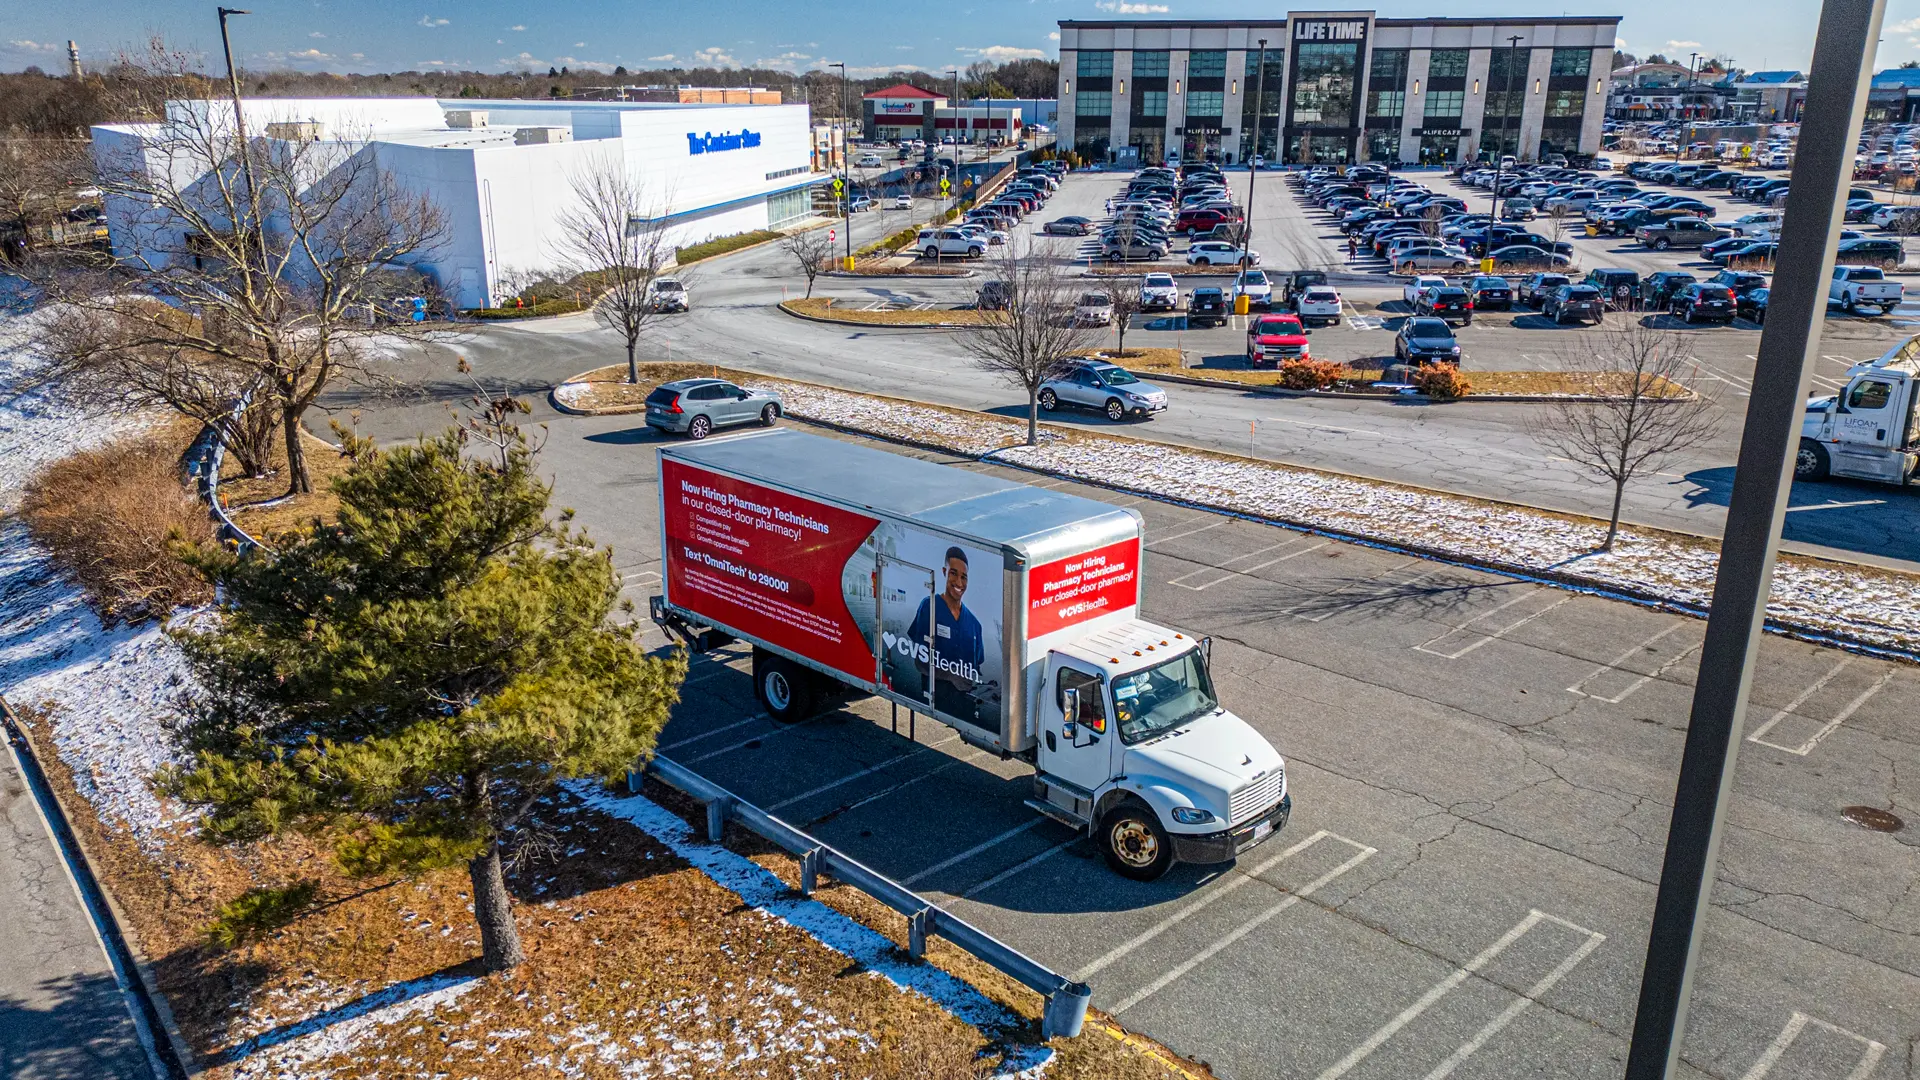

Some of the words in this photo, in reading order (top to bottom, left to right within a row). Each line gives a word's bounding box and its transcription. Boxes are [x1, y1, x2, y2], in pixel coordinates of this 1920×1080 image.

[1296, 22, 1326, 39] LIFE
[1327, 22, 1364, 39] TIME
[1845, 417, 1878, 428] LIFOAM
[681, 480, 700, 495] Now
[701, 486, 726, 505] Hiring
[728, 494, 772, 519] Pharmacy
[773, 507, 829, 534] Technicians
[682, 494, 690, 505] in
[690, 498, 704, 510] our
[705, 502, 754, 525] closed-door
[755, 517, 802, 541] pharmacy!
[683, 546, 702, 562] Text
[748, 570, 758, 582] to
[758, 573, 789, 593] 29000!
[1043, 575, 1081, 592] Pharmacy
[1082, 562, 1125, 581] Technicians
[1065, 562, 1082, 574] Now
[1083, 556, 1106, 569] Hiring
[1032, 600, 1040, 608] in
[1041, 596, 1054, 606] our
[1054, 583, 1097, 602] closed-door
[1097, 570, 1134, 591] pharmacy!
